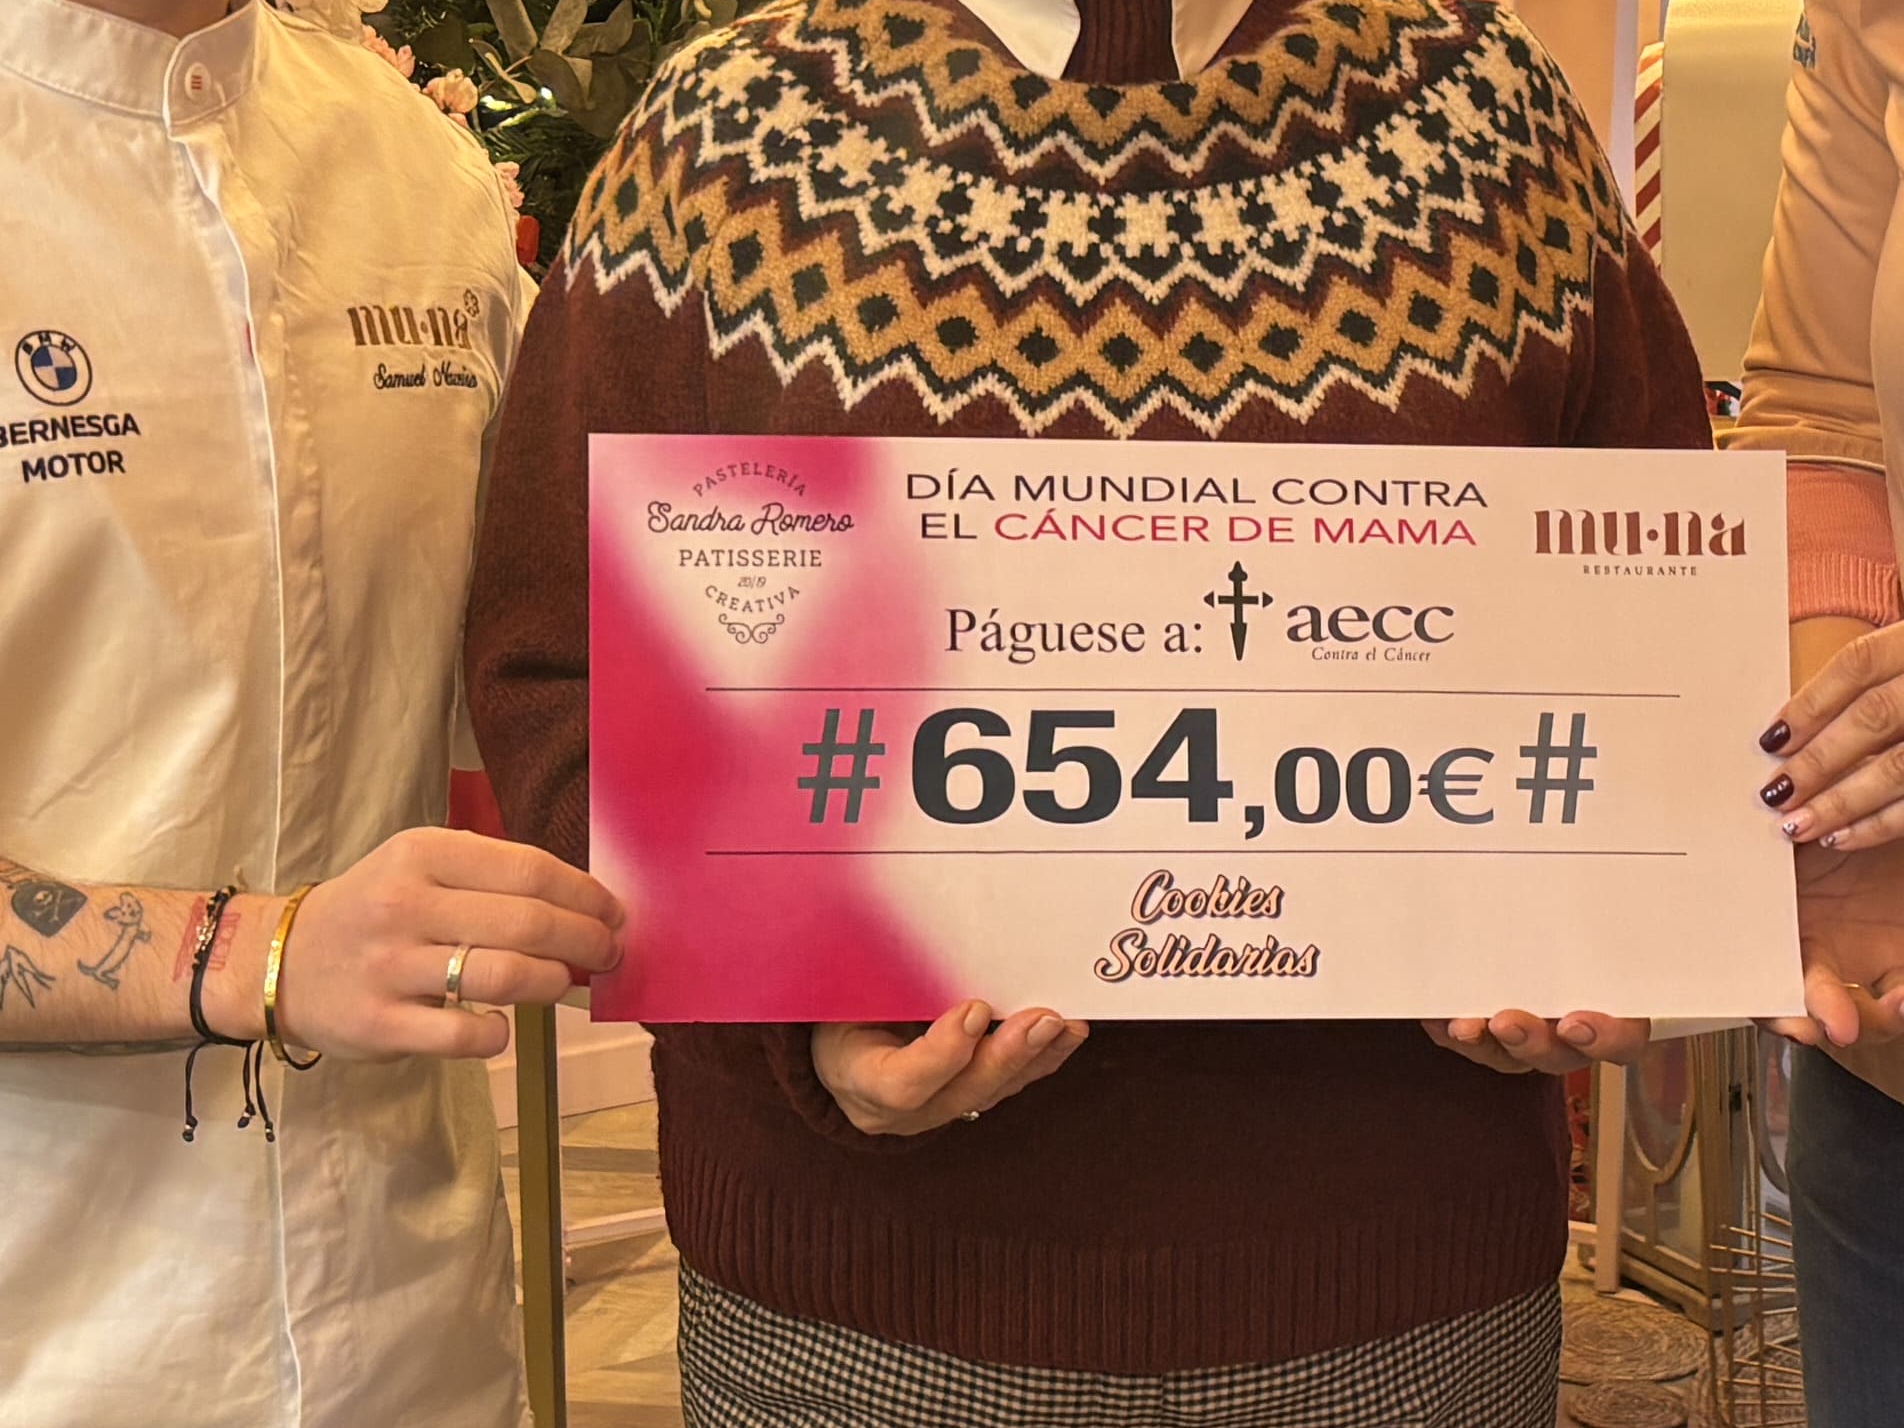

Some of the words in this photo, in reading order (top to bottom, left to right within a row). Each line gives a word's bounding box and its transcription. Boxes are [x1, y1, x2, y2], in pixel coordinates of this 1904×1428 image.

[20, 450, 127, 484] MOTOR
[692, 461, 807, 498] PASTELERÍA
[906, 467, 995, 502] DÍA
[1013, 474, 1257, 506] MUNDIAL
[1271, 478, 1489, 509] CONTRA
[647, 501, 746, 533] Sandra
[750, 502, 855, 536] Romero
[920, 512, 978, 541] EL
[994, 508, 1210, 544] CÁNCER
[1228, 516, 1296, 545] DE
[1313, 518, 1478, 547] MAMA
[678, 548, 823, 568] PATISSERIE
[1582, 563, 1698, 577] RESTAURANTE
[704, 584, 801, 614] CREATIVA
[944, 606, 1147, 665] Páguese
[1163, 620, 1204, 654] a:
[1285, 603, 1455, 645] aecc
[1310, 646, 1361, 663] Contra
[1364, 647, 1378, 663] el
[1382, 647, 1432, 663] Cáncer
[911, 707, 1498, 841] 654,00€
[1129, 868, 1286, 927] Cookies
[1093, 927, 1322, 985] Solidarias
